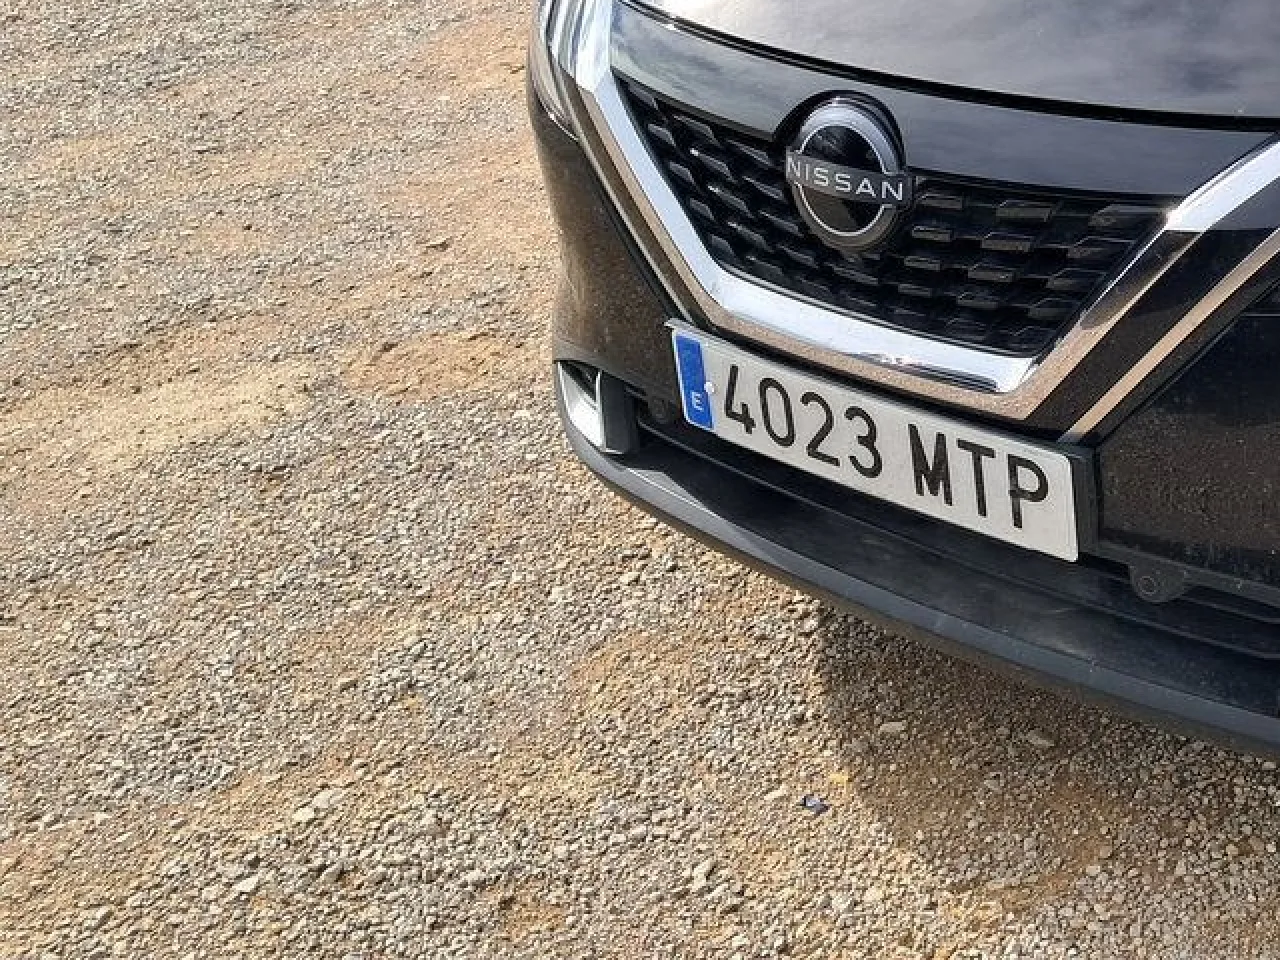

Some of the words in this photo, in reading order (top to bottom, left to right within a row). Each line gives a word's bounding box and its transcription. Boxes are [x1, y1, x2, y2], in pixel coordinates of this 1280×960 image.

[786, 155, 903, 201] NISSAN
[690, 390, 704, 412] E
[724, 365, 883, 479] 4023
[907, 423, 1049, 529] MTP
